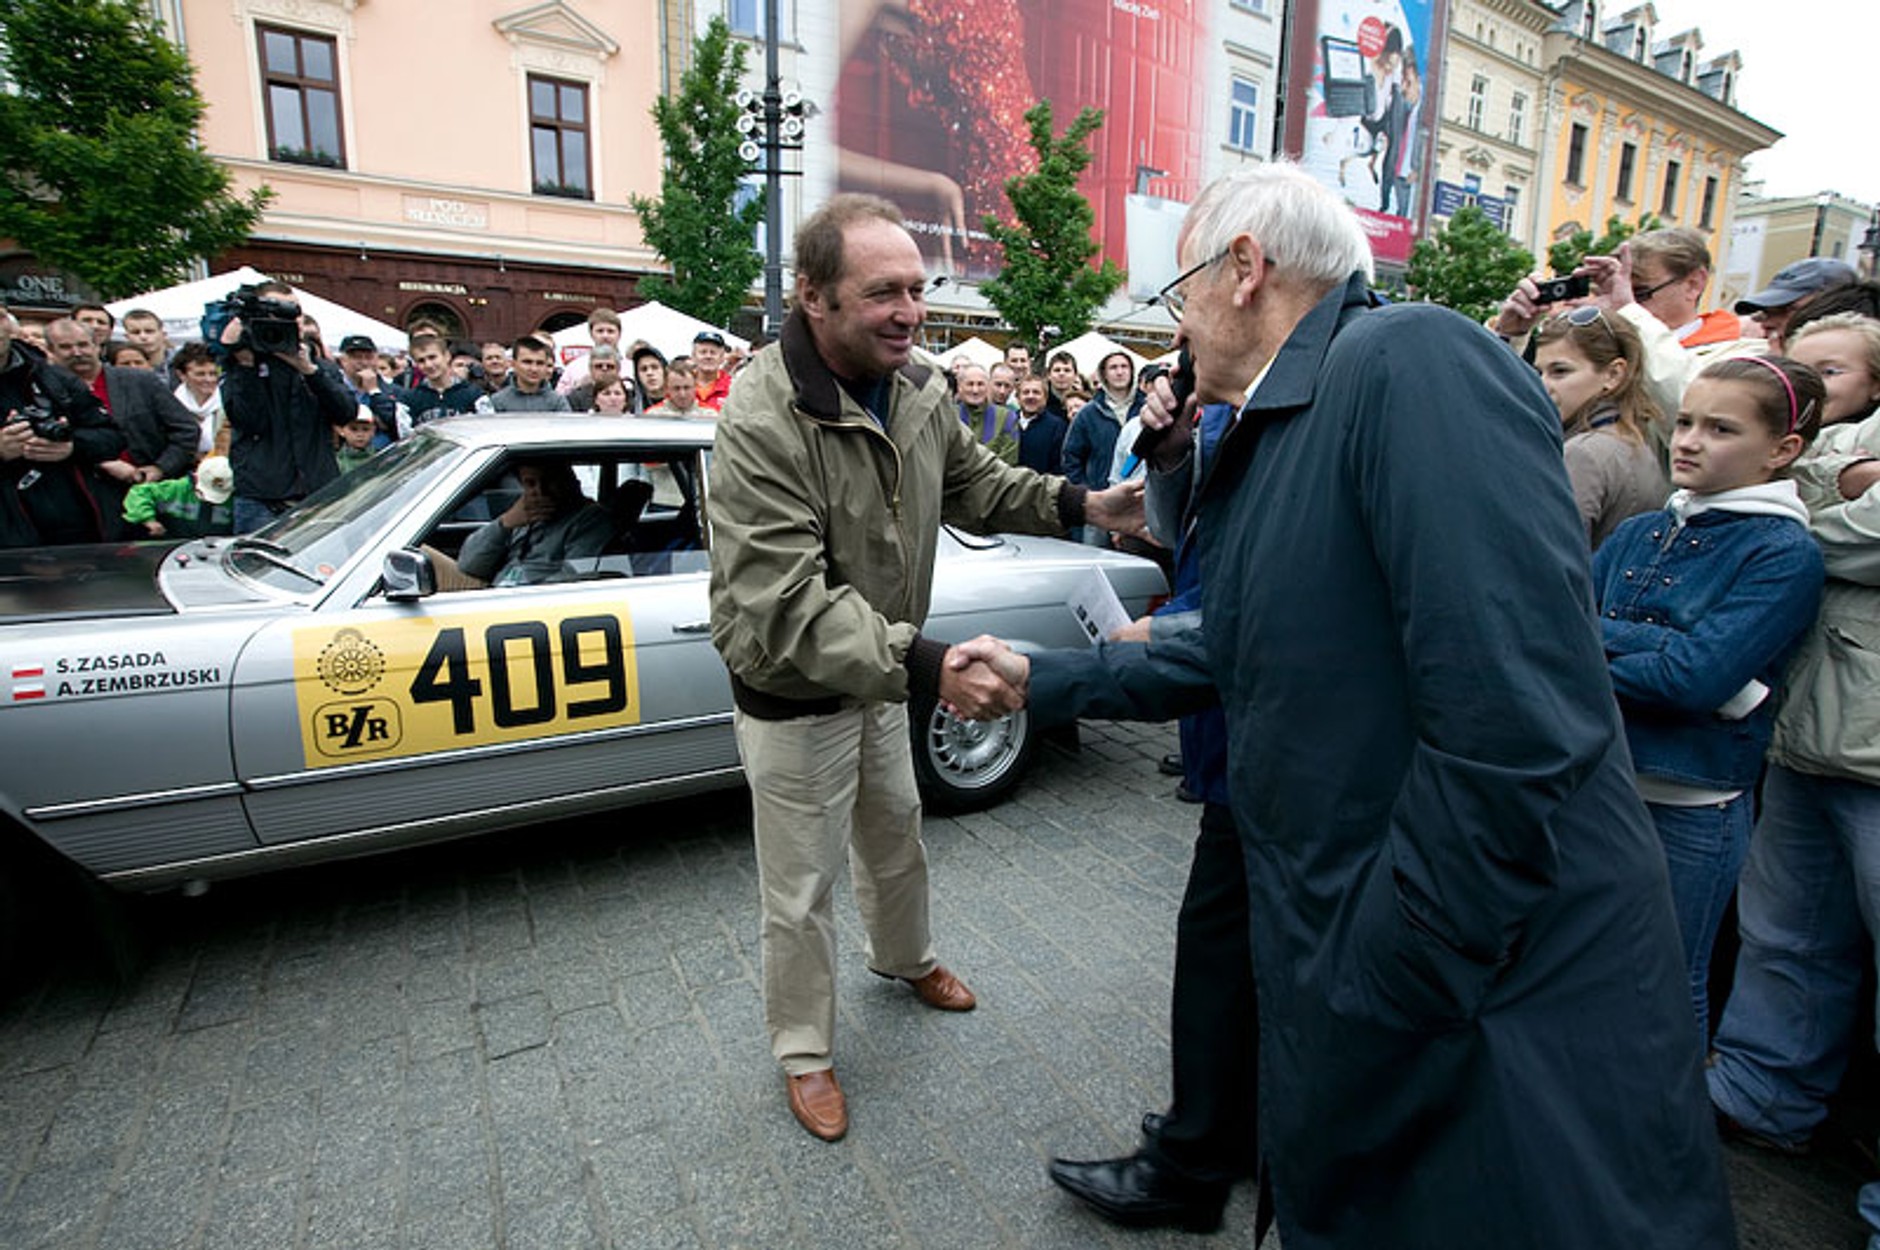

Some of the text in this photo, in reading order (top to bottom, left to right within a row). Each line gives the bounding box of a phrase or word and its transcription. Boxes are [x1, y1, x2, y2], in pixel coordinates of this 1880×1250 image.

[430, 198, 465, 213] POD
[18, 274, 64, 293] ONE
[56, 651, 166, 674] S.ZASADA
[57, 667, 220, 697] A.ZEMBRZUSKI
[409, 614, 627, 735] 409
